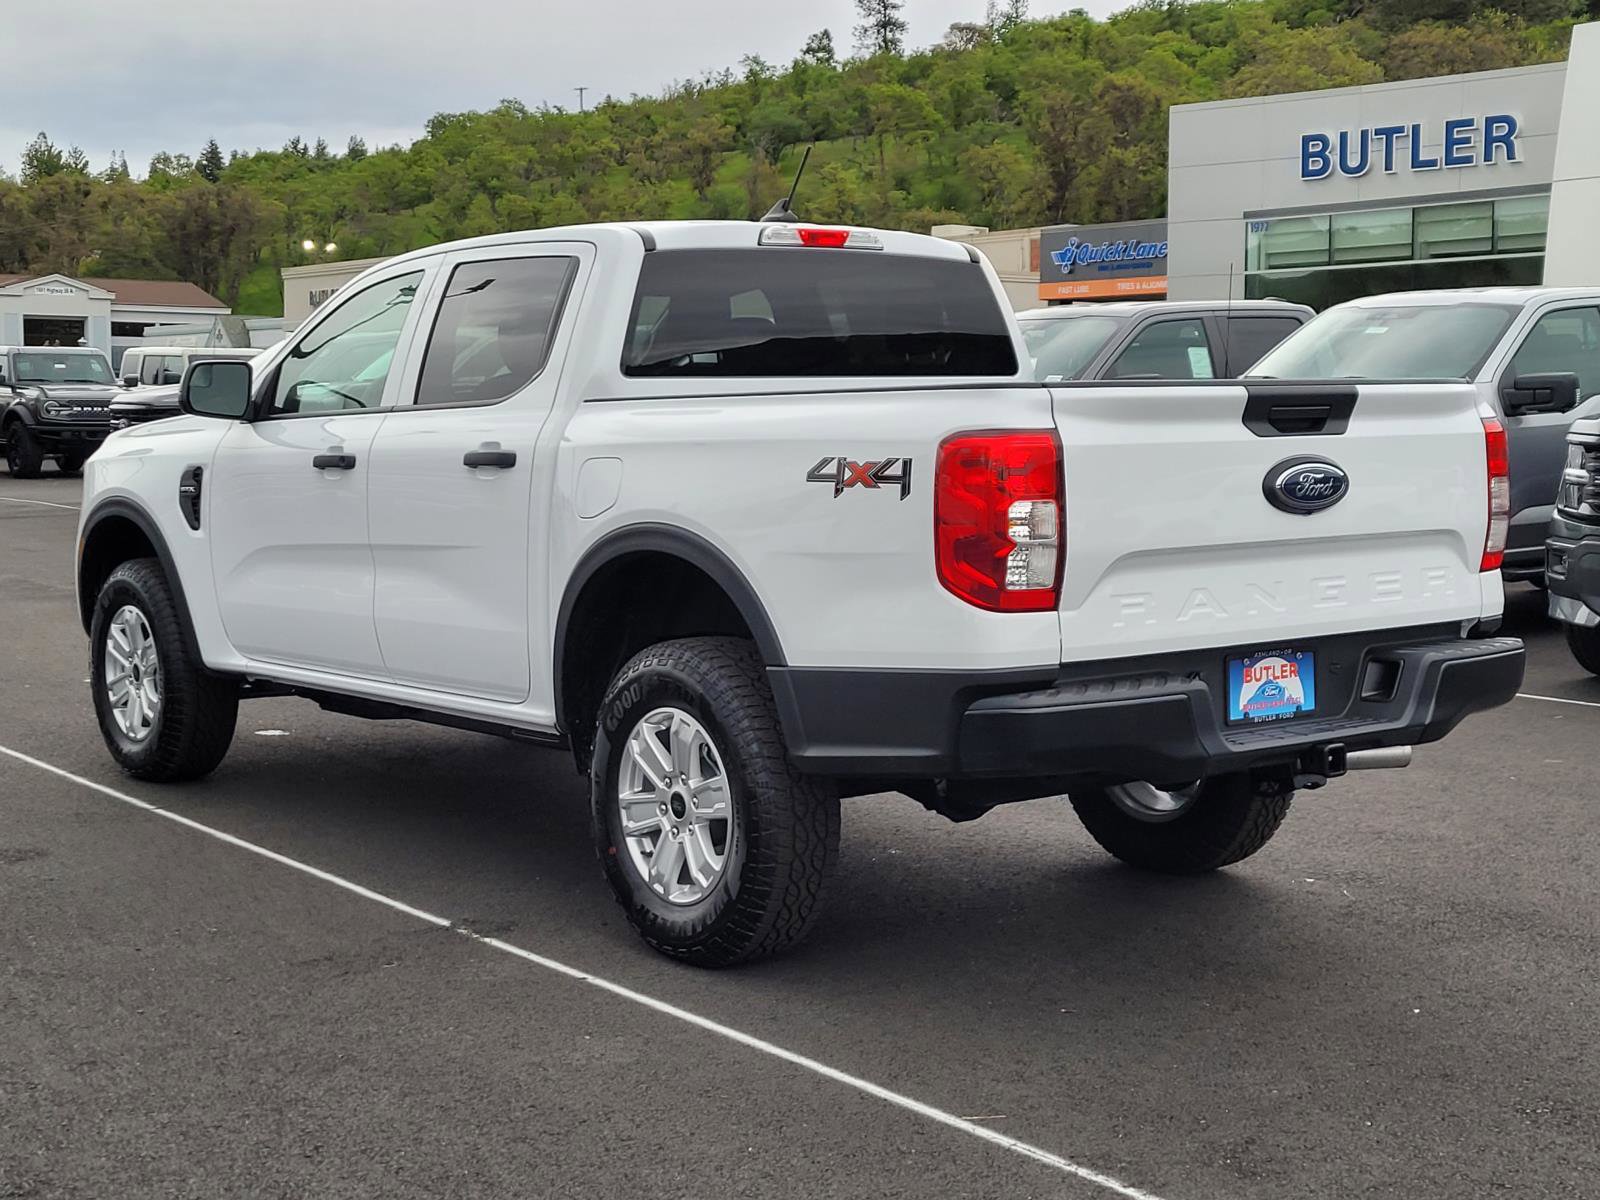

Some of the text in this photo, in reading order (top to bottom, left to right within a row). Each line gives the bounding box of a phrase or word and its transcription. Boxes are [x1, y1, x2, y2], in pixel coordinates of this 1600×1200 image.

[1301, 114, 1522, 181] BUTLER
[1058, 285, 1073, 294] FAST
[1296, 472, 1334, 497] Ford
[1110, 566, 1456, 627] RANGER
[1244, 663, 1297, 683] BUTLER
[1264, 686, 1279, 696] Ford
[1254, 711, 1295, 722] BUTLER FORD
